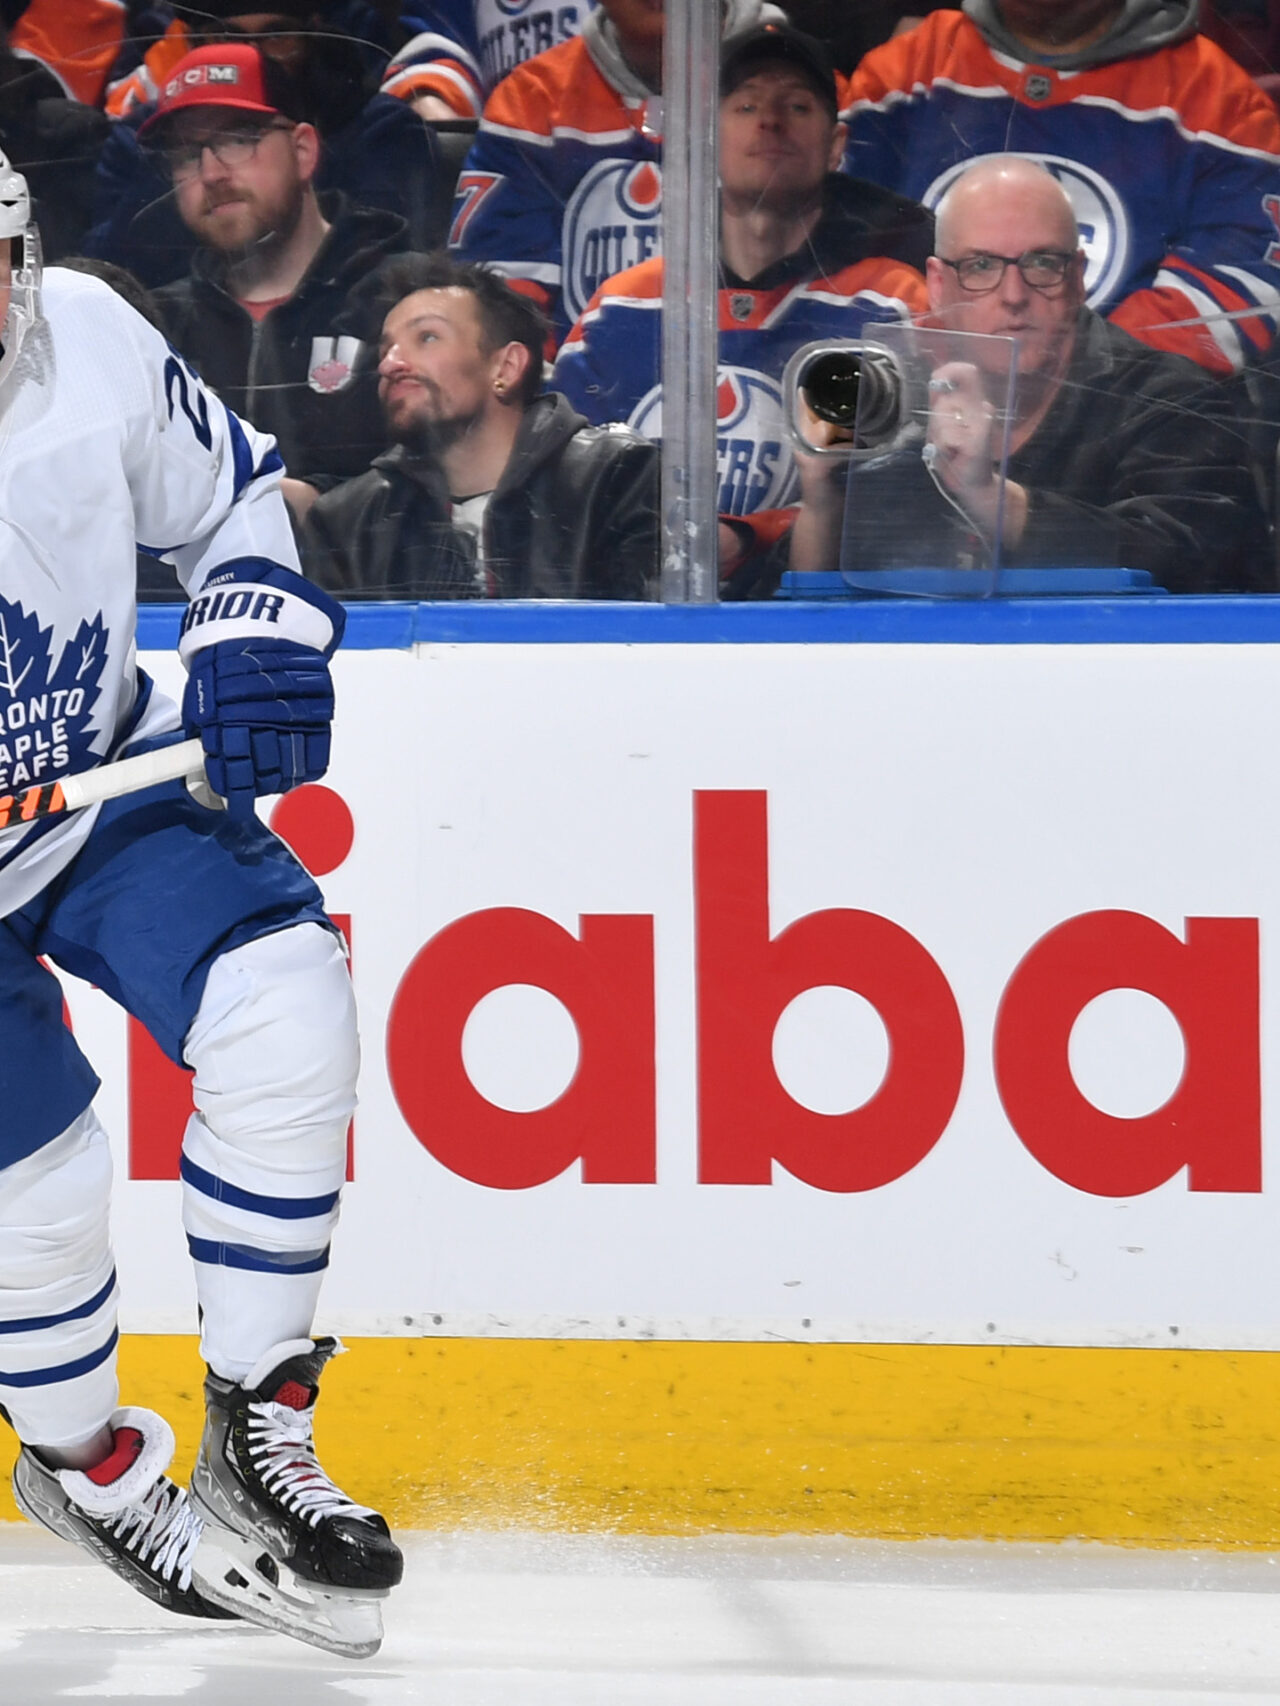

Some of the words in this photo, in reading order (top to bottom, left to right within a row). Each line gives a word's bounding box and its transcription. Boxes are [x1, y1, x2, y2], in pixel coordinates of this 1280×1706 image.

[166, 66, 234, 96] CCM
[164, 341, 211, 452] 2
[184, 591, 285, 632] RIOR
